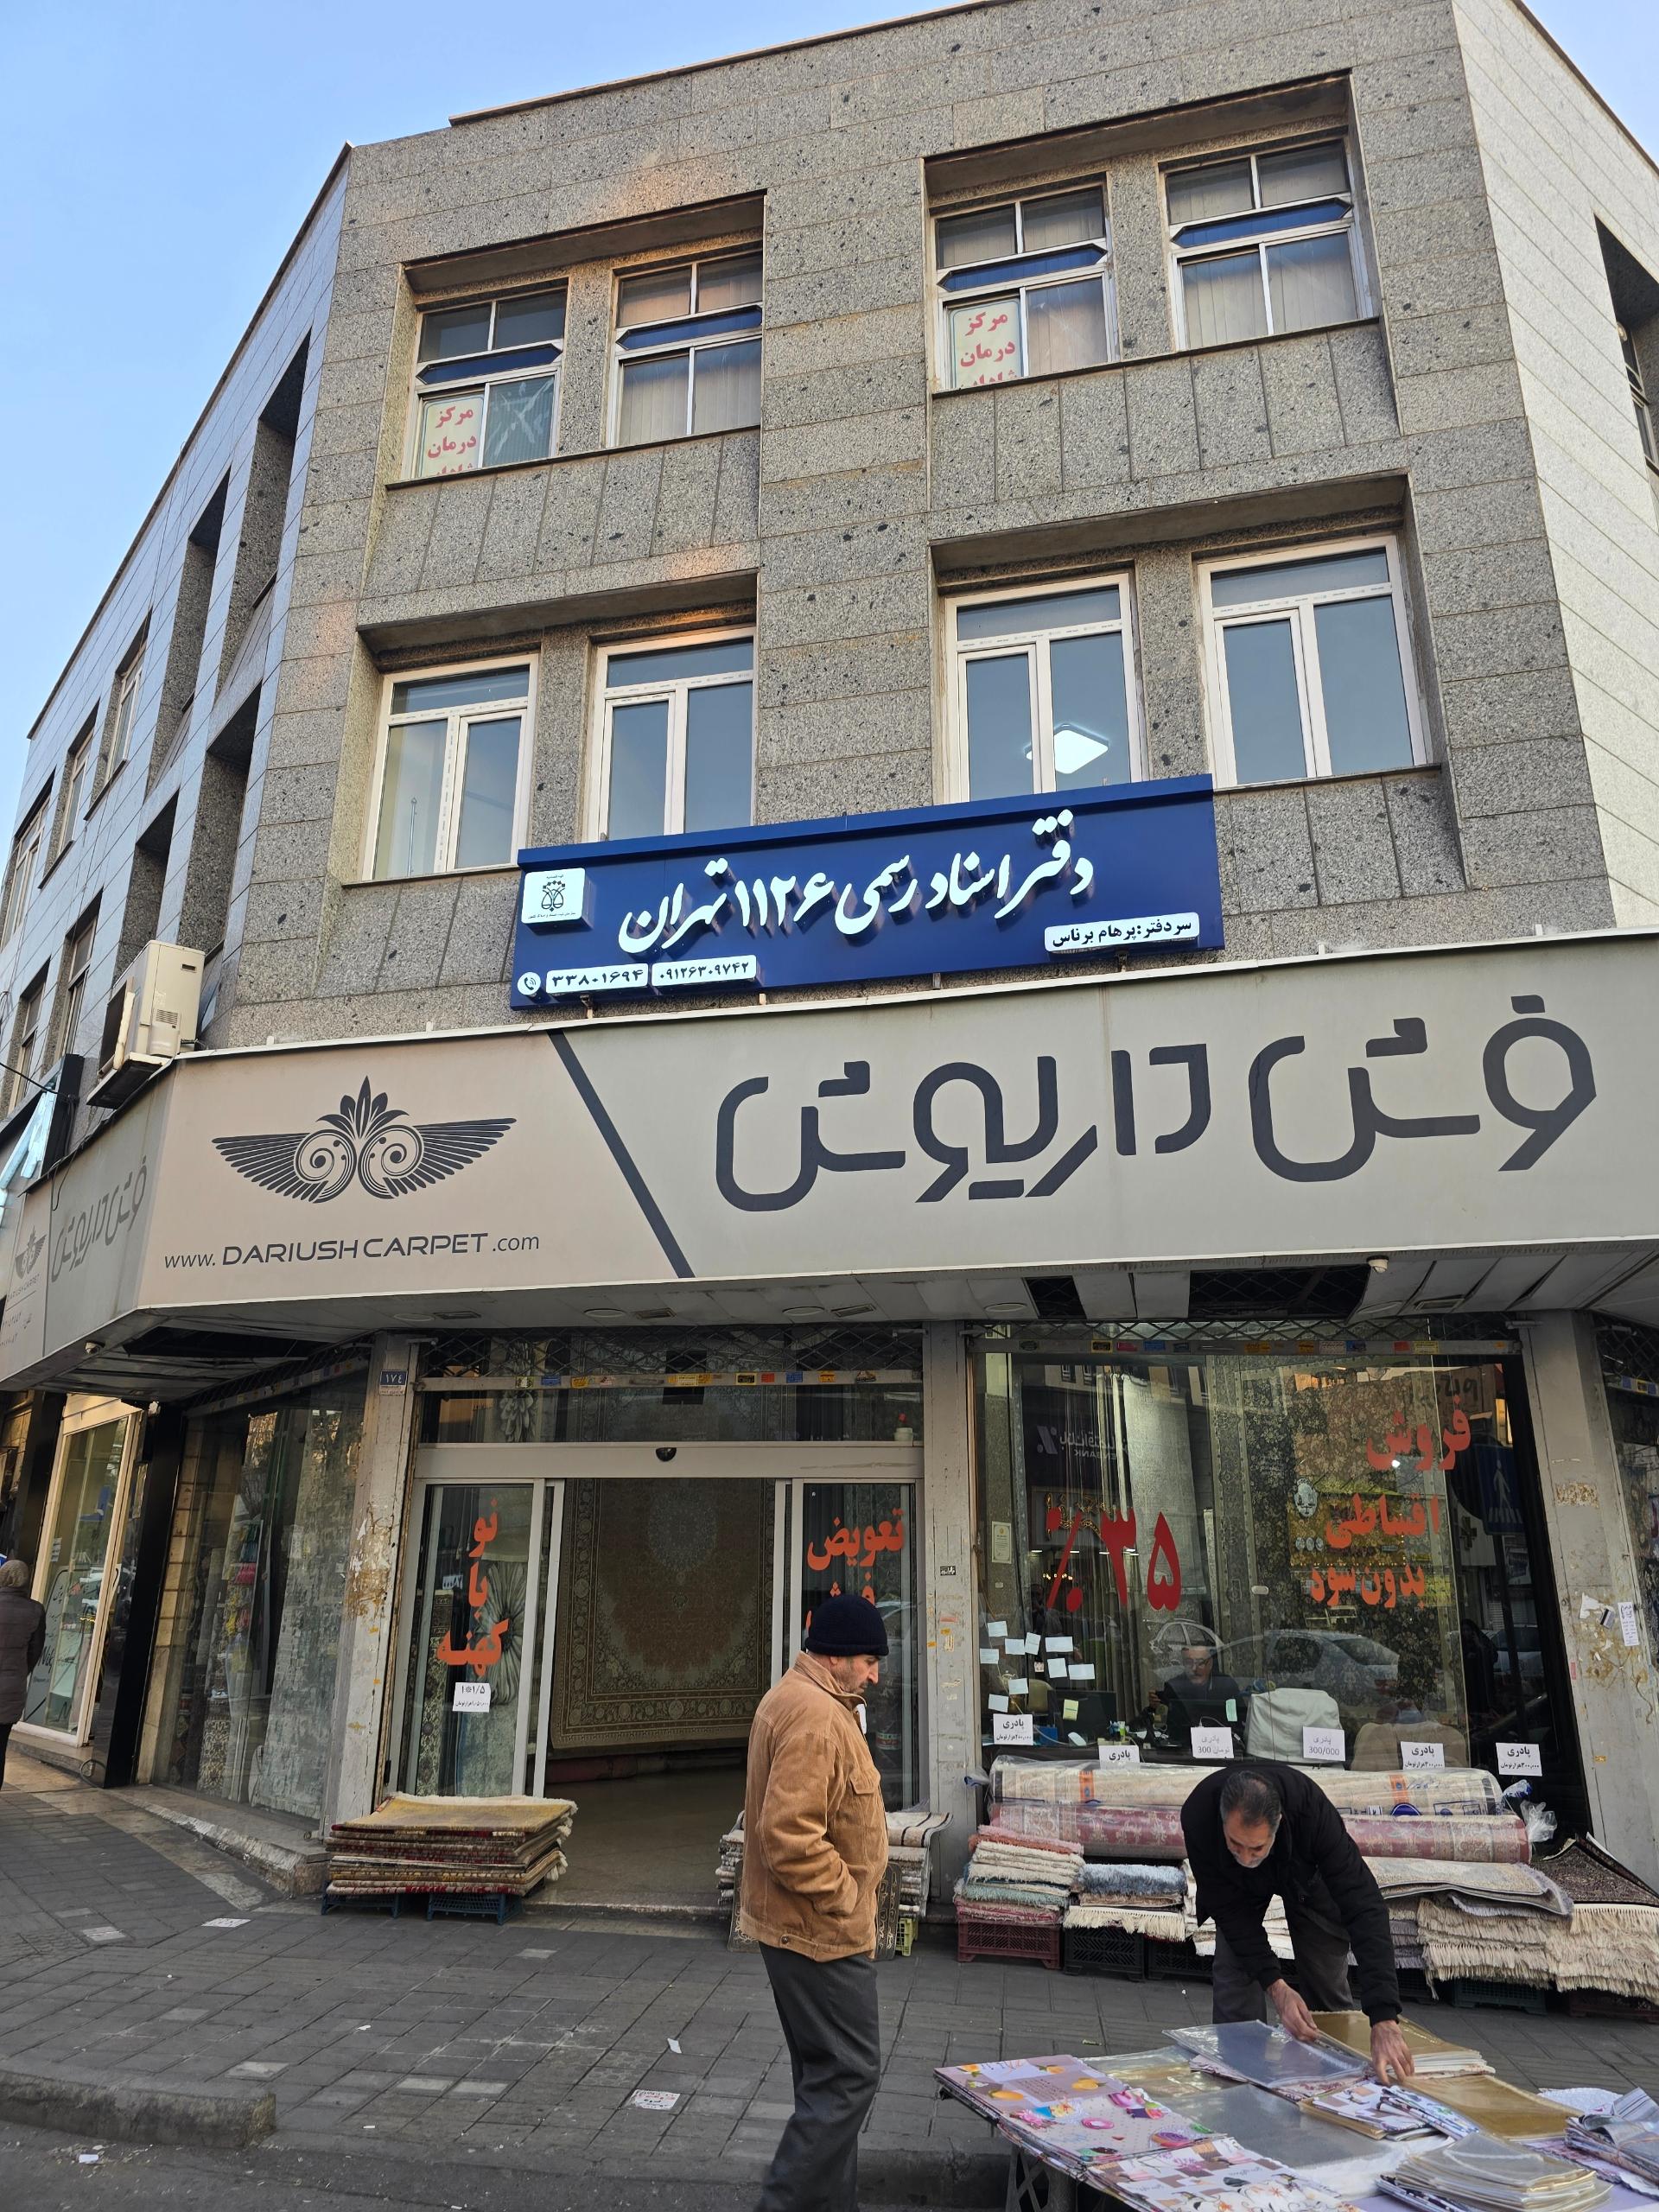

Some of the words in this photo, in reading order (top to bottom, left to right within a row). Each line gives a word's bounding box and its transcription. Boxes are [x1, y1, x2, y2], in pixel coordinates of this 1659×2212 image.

[964, 311, 1008, 336] مرکز
[960, 340, 1015, 367] درمان
[435, 405, 474, 429] مرکز
[427, 435, 477, 459] درمان
[925, 851, 1011, 909] اسناد
[994, 809, 1094, 918] دفتر
[618, 857, 728, 954] تهران
[734, 872, 835, 927] ۱۱۲۶
[835, 854, 918, 935] رسمی
[1052, 927, 1094, 948] برناس
[551, 969, 645, 987] ۳۳۸۰۱۶۹۴
[659, 962, 749, 980] ۰۹۱۲۶۳۰۹۷۴۲
[1248, 995, 1597, 1184] فرش
[715, 1043, 1211, 1212] داریوش
[1366, 1395, 1471, 1471] فروش
[468, 1497, 499, 1558] نو
[807, 1508, 905, 1572] تعویض
[1325, 1491, 1440, 1549] اقساطی
[468, 1560, 489, 1618] با
[1310, 1566, 1357, 1607] سود
[1361, 1565, 1426, 1611] بدون
[436, 1618, 510, 1676] کهنه
[1002, 1718, 1025, 1730] پادری
[1411, 1745, 1434, 1758] پادری
[1507, 1745, 1530, 1758] پادری
[1109, 1749, 1131, 1761] پادری
